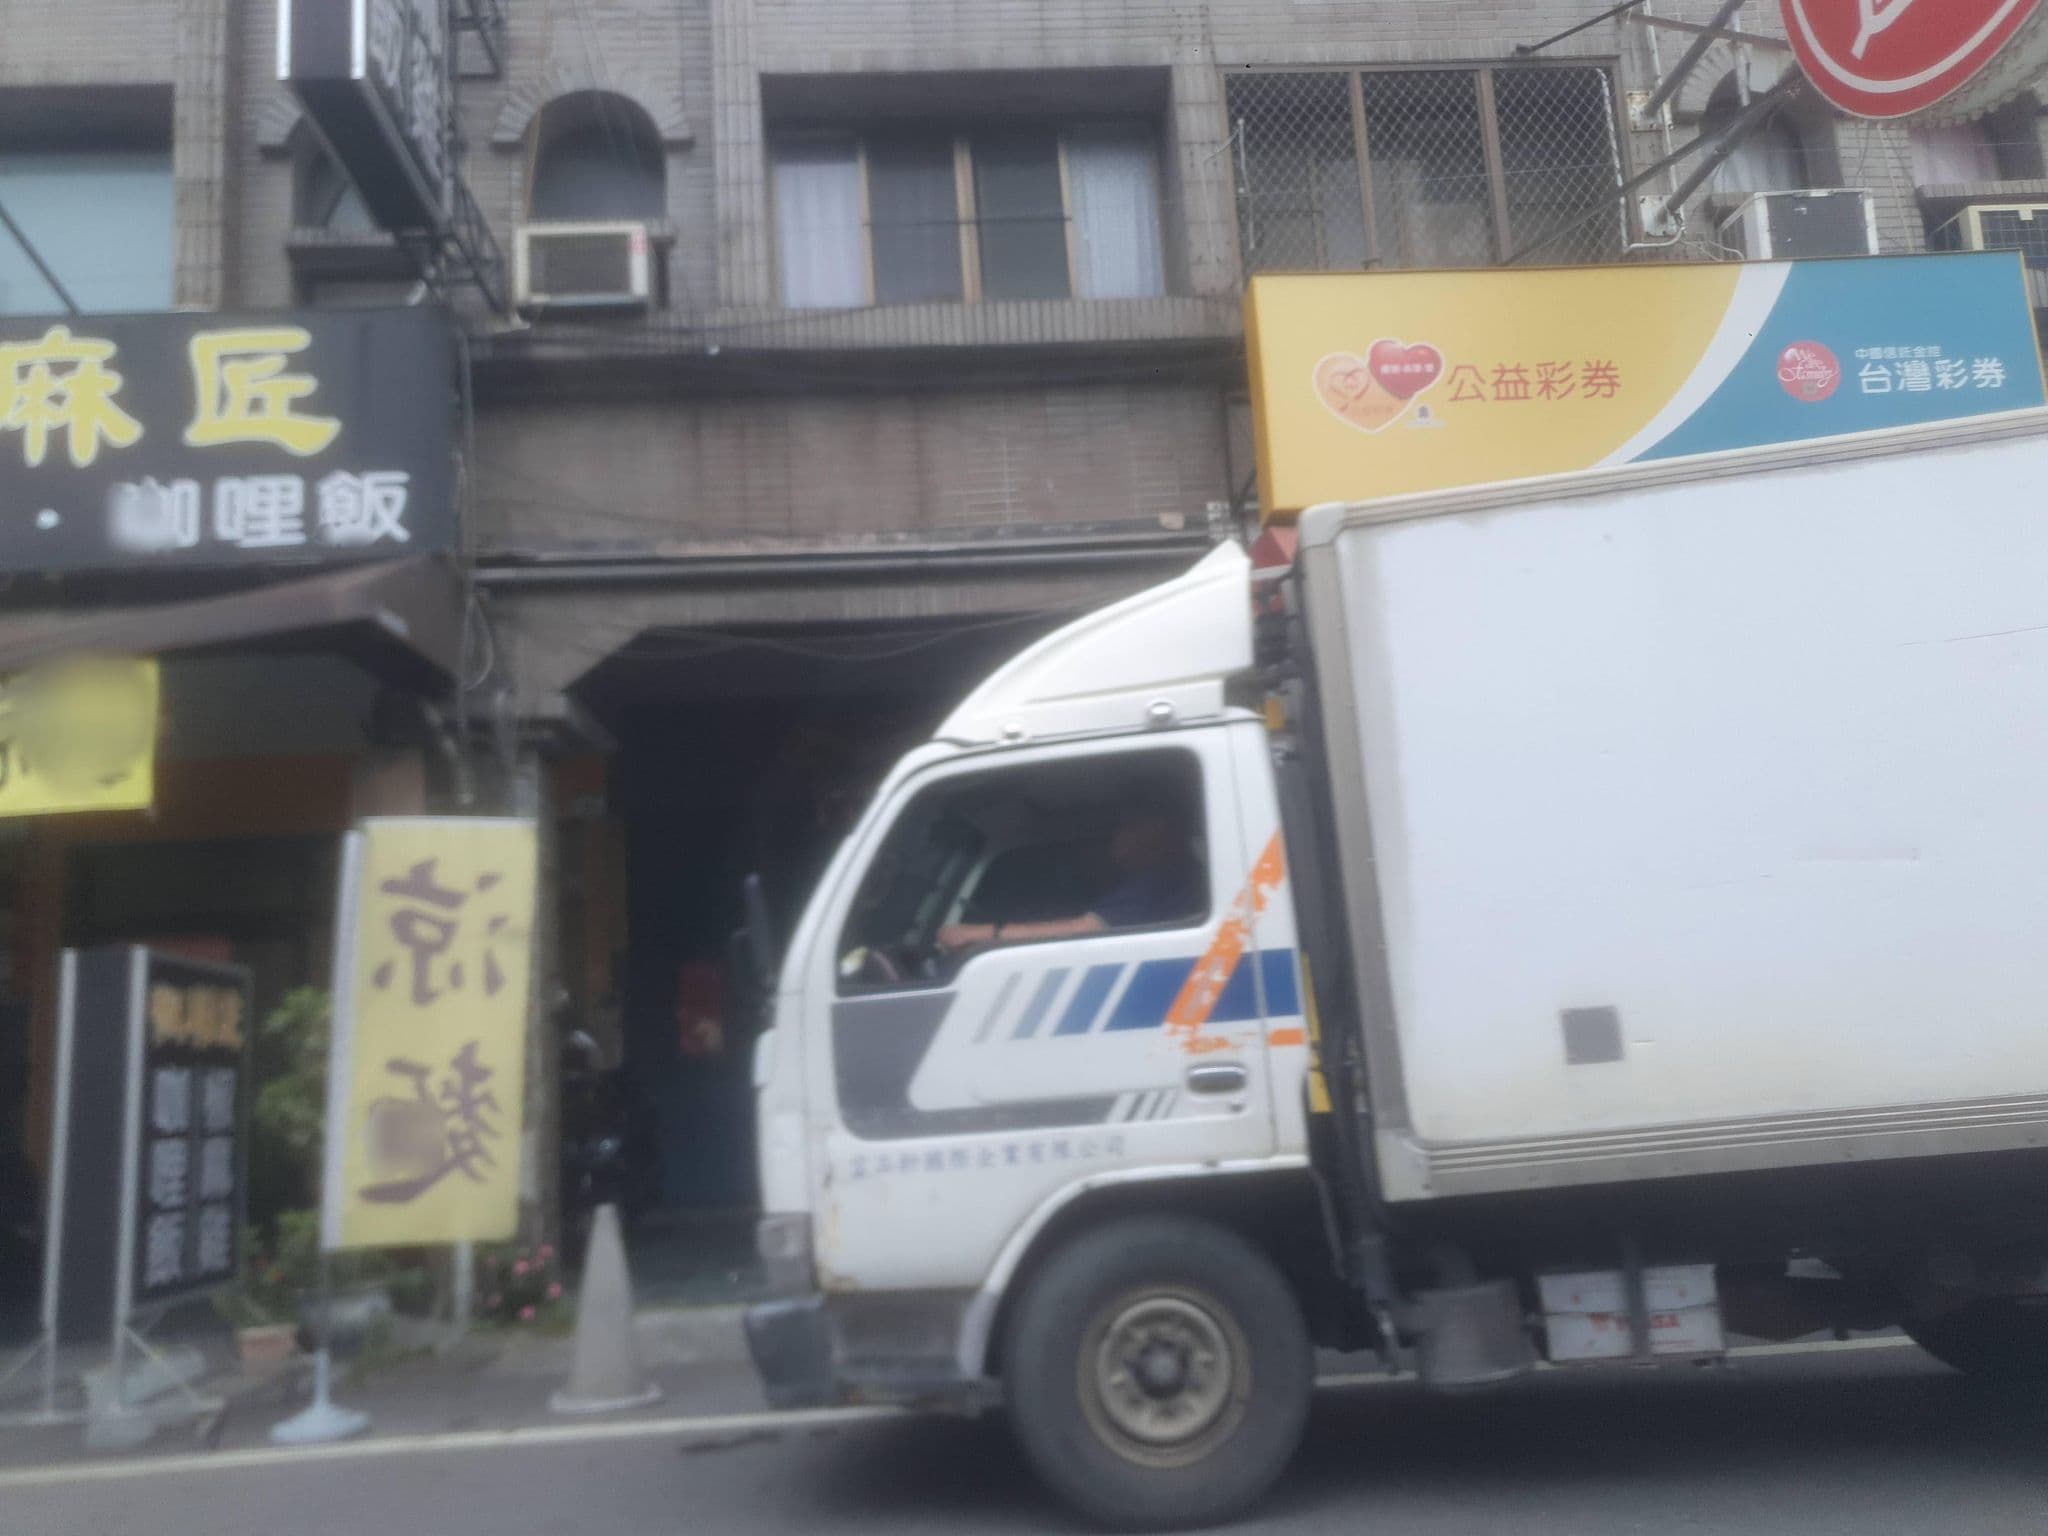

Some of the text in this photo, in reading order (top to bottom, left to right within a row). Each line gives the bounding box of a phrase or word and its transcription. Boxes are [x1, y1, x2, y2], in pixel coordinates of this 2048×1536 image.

[0, 325, 342, 467] 麻匠
[1447, 360, 1621, 402] 公益彩券
[1858, 357, 2006, 394] 台灣彩券
